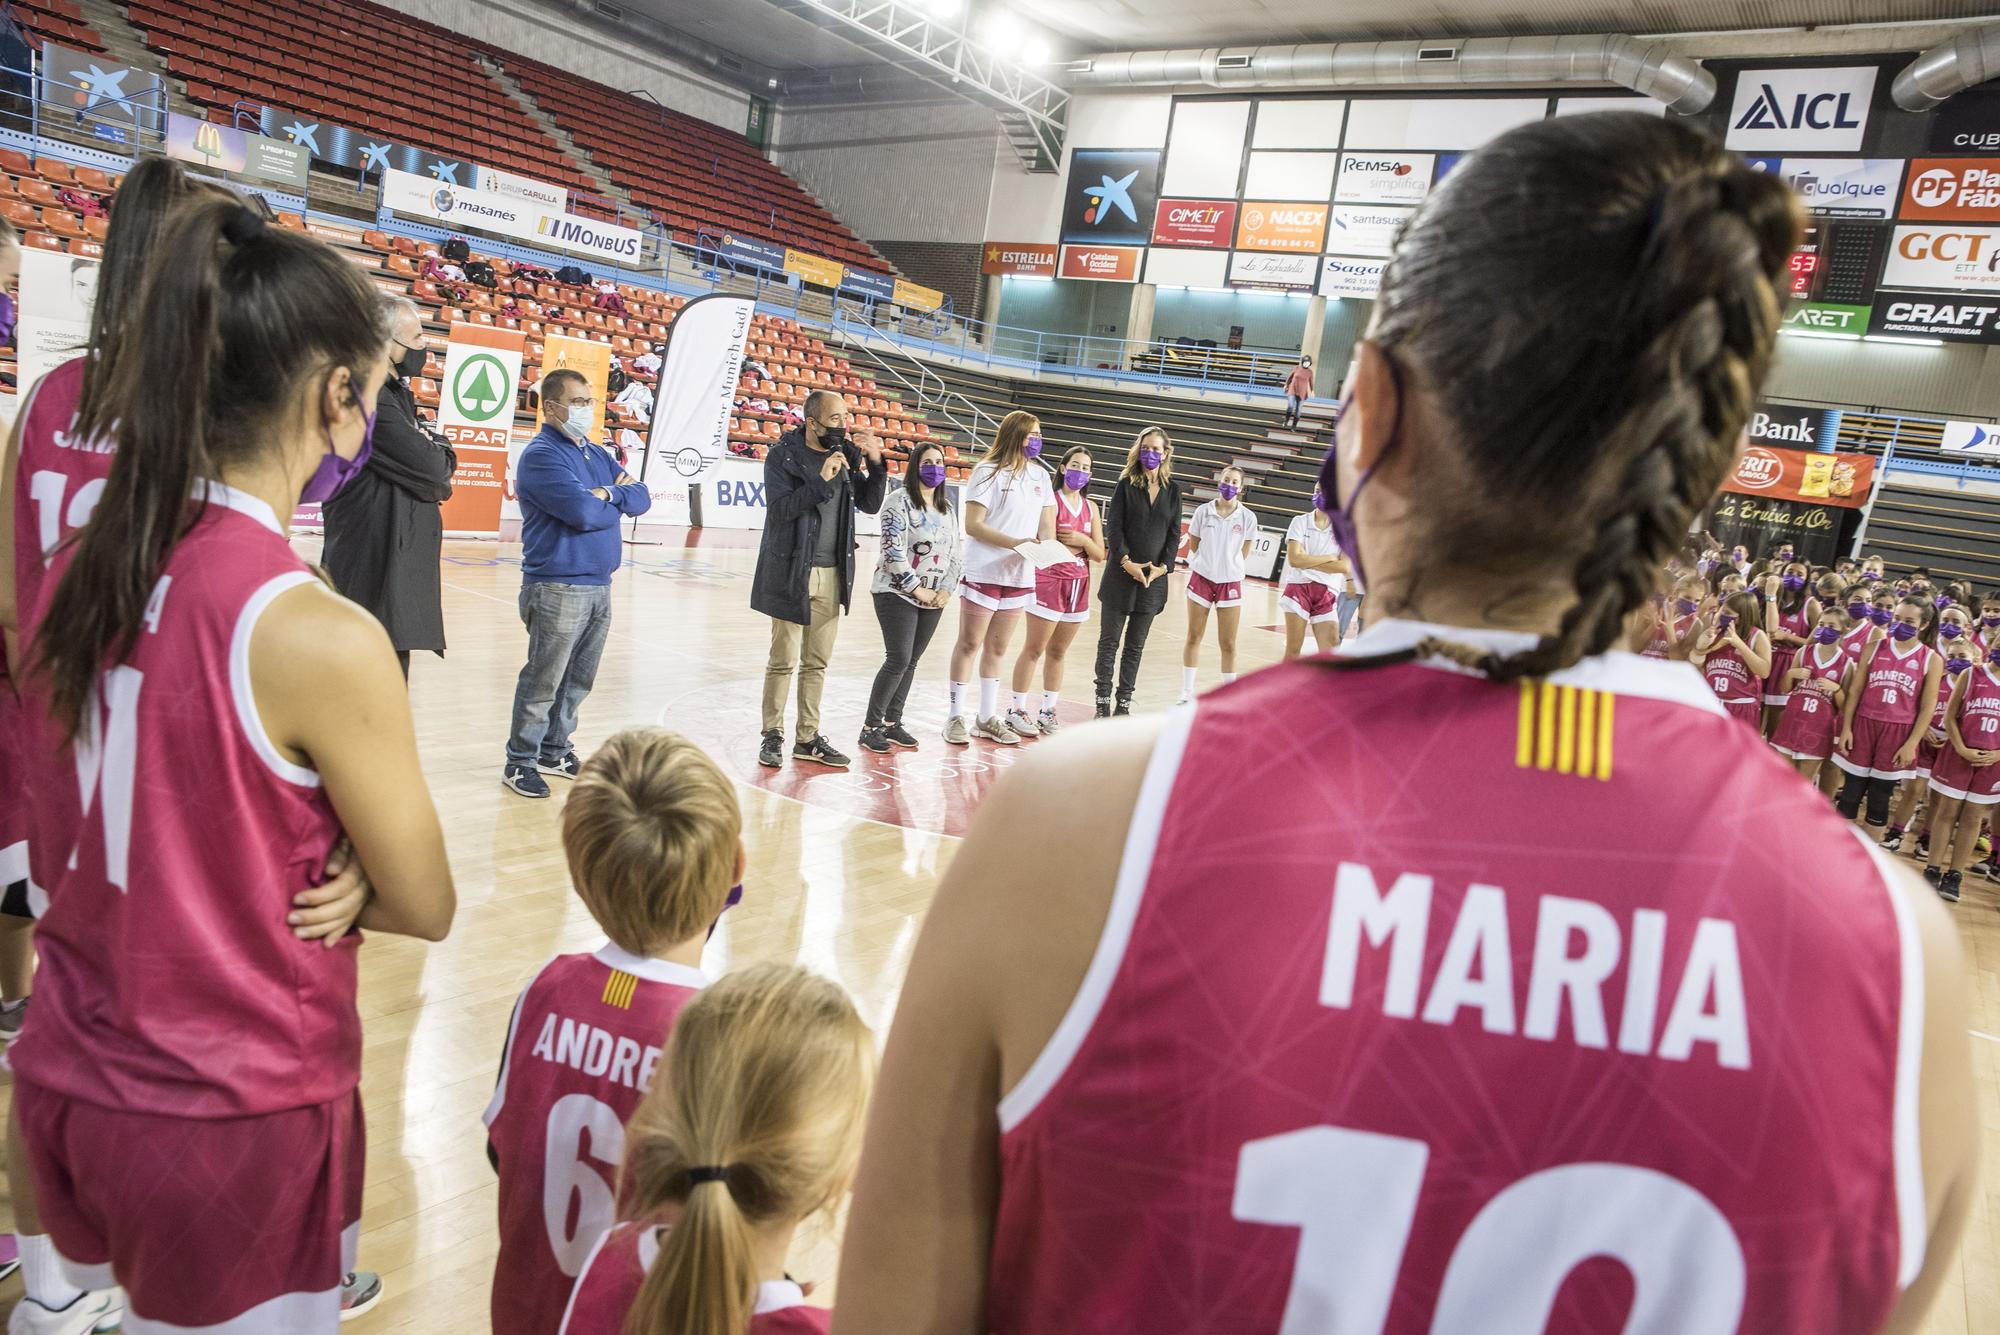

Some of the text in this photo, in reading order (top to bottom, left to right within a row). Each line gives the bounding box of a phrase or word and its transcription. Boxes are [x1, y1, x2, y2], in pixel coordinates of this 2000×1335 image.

[1343, 157, 1403, 176] REMSA
[1369, 176, 1426, 192] simplifica
[1914, 175, 1958, 199] PF
[1268, 209, 1325, 227] NACEX
[1898, 231, 1991, 262] GCT
[1001, 251, 1054, 266] ESTRELLA
[1791, 255, 1817, 273] 53
[1794, 277, 1806, 290] 2
[1886, 302, 1998, 328] CRAFT
[711, 402, 728, 447] Motor
[720, 342, 742, 400] Munich
[1751, 411, 1815, 443] Bank
[444, 428, 507, 445] SPAR
[677, 457, 700, 469] MINI
[1255, 538, 1270, 552] 10
[1713, 676, 1729, 693] 19
[1868, 669, 1918, 693] MANRESA
[1802, 696, 1819, 714] 18
[1881, 688, 1899, 705] 16
[1980, 716, 1999, 734] 10
[1317, 860, 1753, 1072] MARIA
[542, 1092, 628, 1279] 6
[1230, 1123, 1750, 1335] 1
